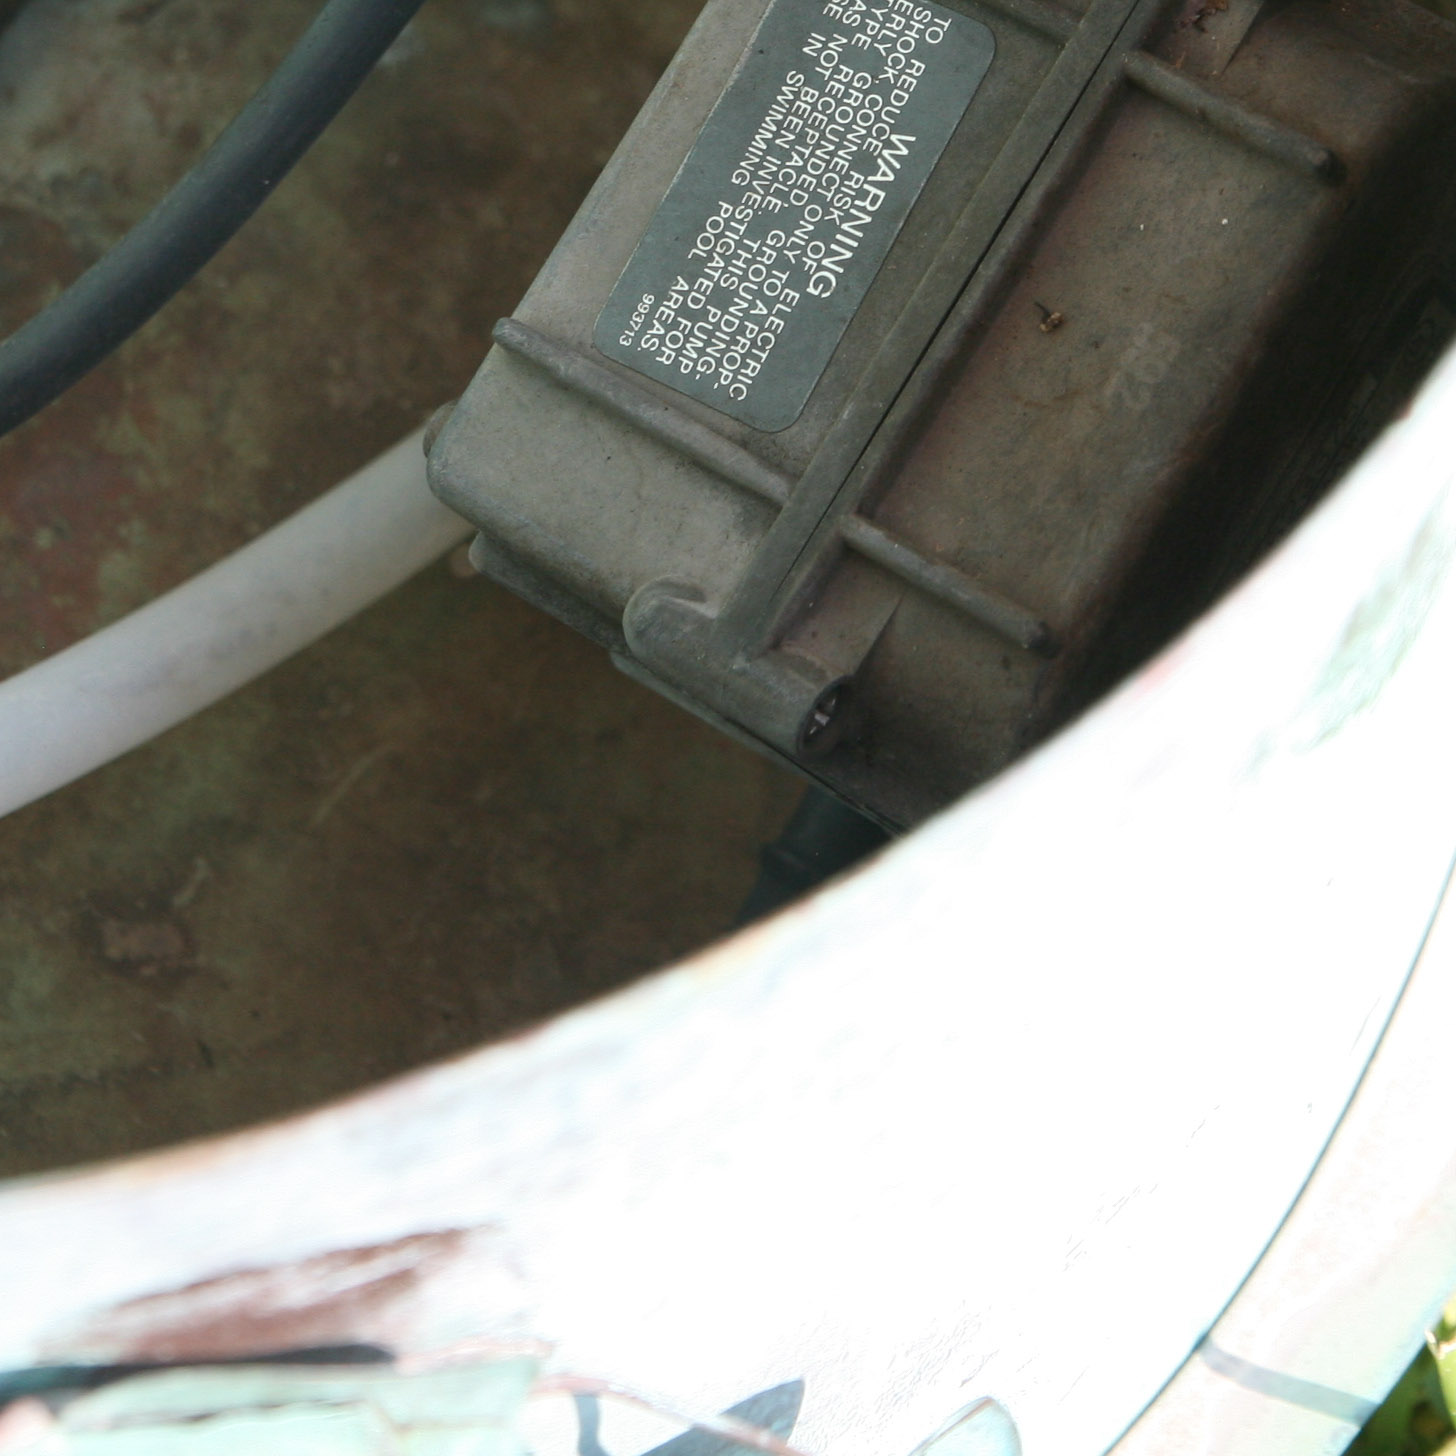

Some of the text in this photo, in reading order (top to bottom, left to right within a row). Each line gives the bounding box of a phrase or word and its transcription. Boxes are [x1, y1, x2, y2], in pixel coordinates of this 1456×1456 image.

[801, 32, 827, 57] IN
[814, 33, 849, 81] NOT
[730, 70, 805, 186] SWIMMING
[757, 64, 855, 215] RECEPTACLE.
[776, 86, 820, 149] BEEN
[782, 71, 872, 208] GROUNDED,
[687, 200, 734, 259] POOL
[687, 155, 782, 310] INVESTIGATED
[713, 6, 932, 390] SHOCK, CONNECT ONLY TO A PROP-
[728, 17, 952, 401] TO REDUCE RISK OF ELECTRIC
[805, 133, 917, 299] WARNING
[719, 238, 762, 290] THIS
[619, 293, 655, 347] 993713
[637, 275, 690, 352] AREAS.
[655, 316, 693, 365] FOR
[678, 305, 722, 374] PUMP
[695, 229, 786, 380] GROUNDING-
